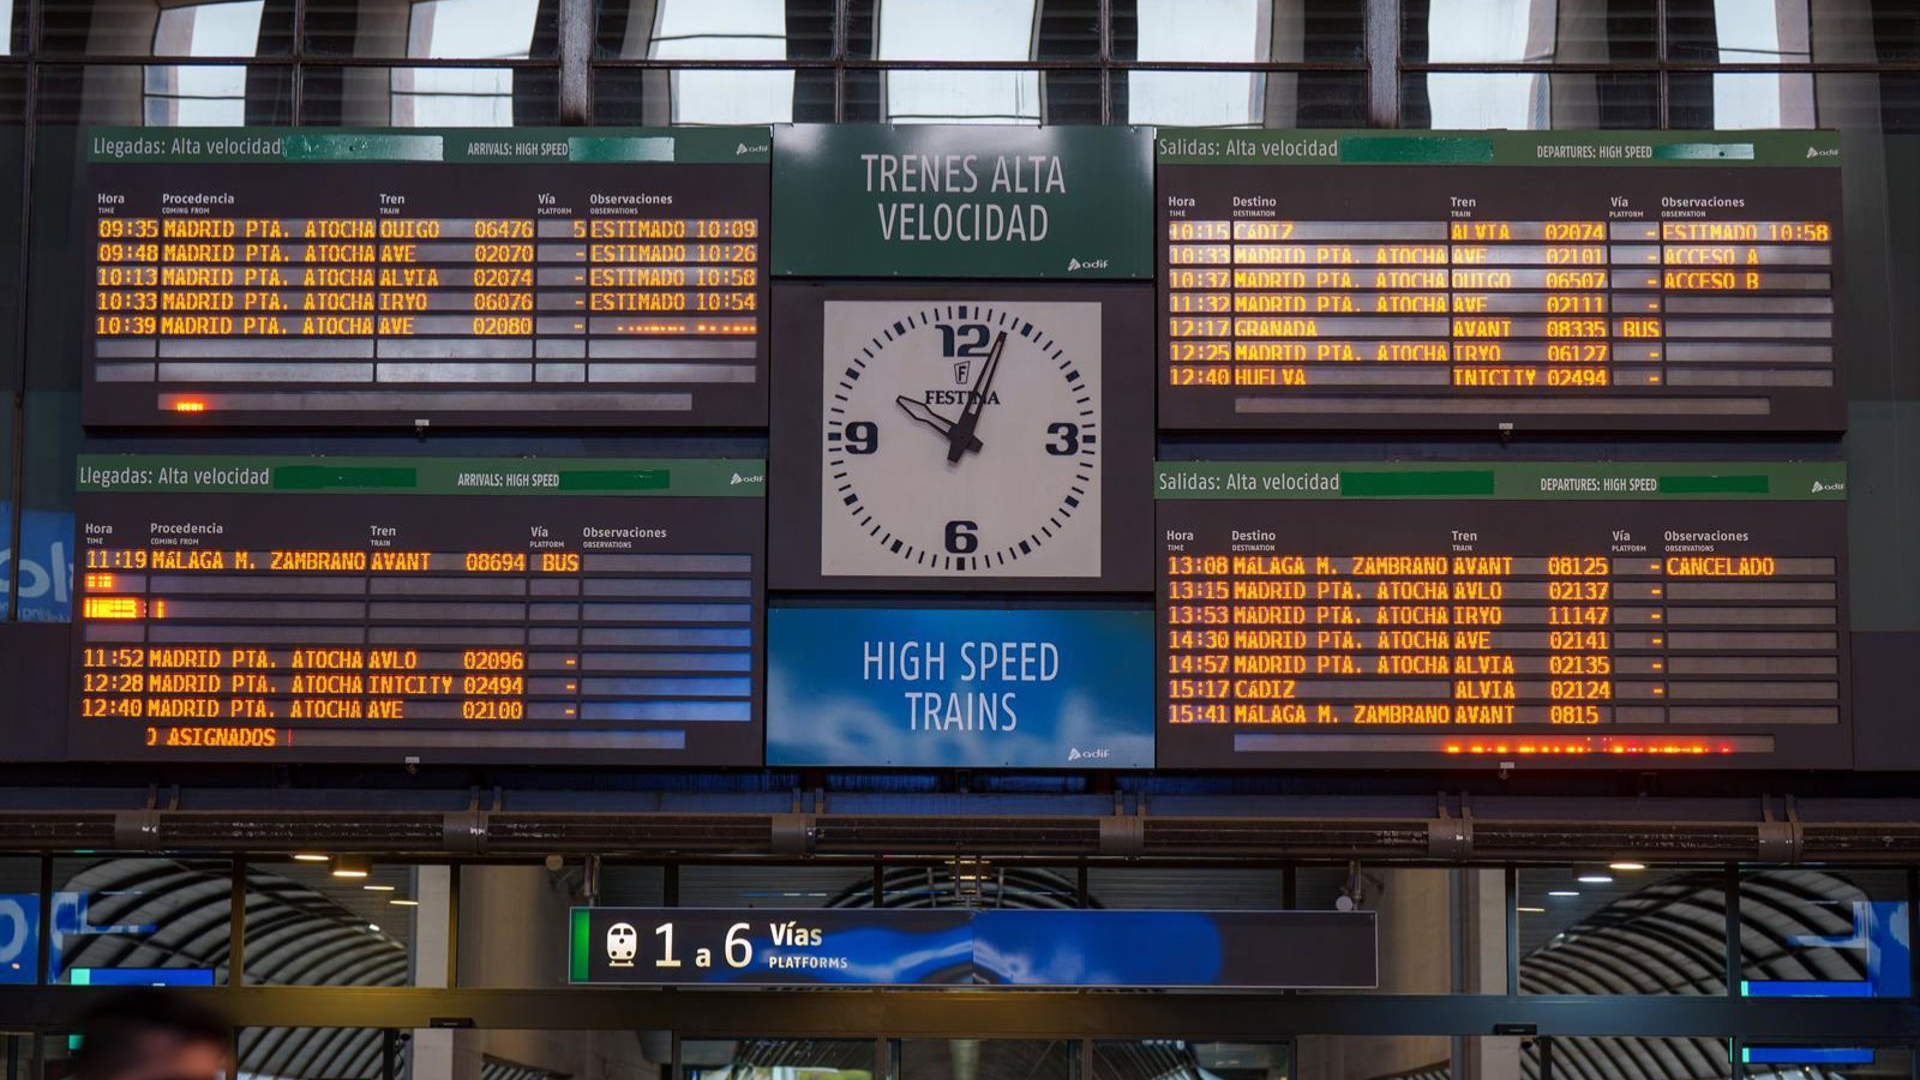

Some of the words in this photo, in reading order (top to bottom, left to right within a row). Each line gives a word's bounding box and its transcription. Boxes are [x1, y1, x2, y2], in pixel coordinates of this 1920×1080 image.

[94, 137, 166, 157] Llegadas:
[172, 138, 200, 155] Alta
[207, 137, 281, 155] velocidad
[468, 143, 512, 155] ARRIVALS:
[516, 143, 538, 156] HIGH
[541, 143, 568, 156] SPEED
[1160, 139, 1220, 155] Salidas:
[1227, 139, 1255, 156] Alta
[1262, 140, 1338, 156] velocidad
[1537, 146, 1596, 158] DEPARTURES:
[1599, 146, 1621, 158] HIGH
[1625, 146, 1652, 158] SPEED
[861, 154, 978, 193] TRENES
[991, 155, 1066, 193] ALTA
[98, 194, 124, 204] Hora
[162, 193, 234, 204] Procedencia
[380, 194, 405, 204] Tren
[538, 193, 555, 204] Vía
[590, 194, 672, 204] Observaciones
[1168, 197, 1195, 207] Hora
[1233, 196, 1276, 207] Destino
[1451, 197, 1476, 207] Tren
[1611, 196, 1628, 207] Vía
[1661, 197, 1744, 208] Observaciones
[100, 220, 158, 238] 09:35
[164, 220, 235, 238] MADRID
[246, 220, 289, 238] PTA.
[305, 220, 376, 238] ATOCHA
[381, 220, 439, 238] OUIGO
[474, 220, 534, 238] 06476
[574, 220, 586, 238] 5
[591, 220, 685, 238] ESTIMADO
[696, 220, 756, 238] 10:09
[879, 203, 1048, 241] VELOCIDAD
[99, 244, 158, 262] 09:48
[380, 244, 415, 262] AVE
[474, 244, 533, 262] 02070
[591, 244, 685, 262] ESTIMADO
[696, 244, 756, 262] 10:26
[98, 269, 157, 286] 10:13
[380, 269, 438, 286] ALVIA
[474, 269, 533, 286] 02074
[591, 269, 685, 286] ESTIMADO
[696, 269, 756, 286] 10:58
[98, 292, 157, 310] 10:33
[379, 292, 426, 310] IRYO
[473, 292, 533, 310] 06076
[591, 292, 685, 310] ESTIMADO
[696, 292, 756, 310] 10:54
[97, 317, 156, 334] 10:39
[161, 317, 232, 334] MADRID
[244, 317, 287, 334] PTA.
[303, 317, 374, 334] ATOCHA
[379, 317, 413, 334] AVE
[473, 317, 532, 334] 02080
[935, 324, 991, 357] 12
[845, 421, 878, 454] 9
[1046, 423, 1079, 456] 3
[80, 467, 152, 487] Llegadas:
[158, 468, 188, 484] Alta
[194, 468, 269, 485] velocidad
[458, 474, 503, 487] ARRIVALS:
[506, 474, 529, 487] HIGH
[532, 474, 560, 487] SPEED
[1160, 474, 1220, 490] Salidas:
[1226, 474, 1256, 490] Alta
[1263, 473, 1339, 490] velocidad
[1541, 478, 1600, 491] DEPARTURES:
[1604, 478, 1626, 491] HIGH
[1630, 478, 1657, 491] SPEED
[86, 523, 113, 534] Hora
[151, 523, 223, 534] Procedencia
[371, 526, 396, 536] Tren
[531, 526, 548, 538] Vía
[583, 527, 667, 538] Observaciones
[1167, 531, 1194, 541] Hora
[1232, 530, 1276, 541] Destino
[1452, 531, 1477, 541] Tren
[1612, 530, 1630, 542] Vía
[1664, 531, 1748, 542] Observaciones
[945, 521, 978, 554] 6
[87, 551, 147, 569] 11:19
[235, 552, 255, 570] M.
[271, 552, 366, 570] ZAMBRANO
[371, 552, 431, 570] AVANT
[466, 553, 526, 571] 08694
[542, 554, 579, 571] BUS
[1168, 557, 1228, 575] 13:08
[1317, 557, 1338, 575] M.
[1353, 557, 1448, 575] ZAMBRANO
[1453, 557, 1512, 575] AVANT
[1548, 558, 1608, 575] 08125
[1667, 558, 1775, 575] CANCELADO
[1169, 582, 1229, 599] 13:15
[1454, 582, 1502, 600] AVLO
[1550, 582, 1608, 600] 02137
[1169, 606, 1229, 624] 13:53
[1454, 607, 1502, 624] IRYO
[1549, 607, 1608, 624] 11147
[84, 649, 144, 667] 11:52
[150, 650, 221, 668] MADRID
[232, 650, 275, 668] PTA.
[292, 651, 363, 668] ATOCHA
[369, 651, 416, 669] AVLO
[464, 652, 523, 669] 02096
[863, 642, 945, 680] HIGH
[960, 642, 1058, 681] SPEED
[1169, 656, 1229, 673] 14:57
[1455, 656, 1514, 674] ALVIA
[1550, 656, 1610, 674] 02135
[83, 674, 144, 692] 12:28
[369, 676, 452, 694] INTCITY
[464, 676, 523, 694] 02494
[1169, 681, 1230, 698] 15:17
[1456, 681, 1514, 699] ALVIA
[1551, 681, 1610, 699] 02124
[83, 699, 142, 717] 12:40
[367, 701, 404, 718] AVE
[463, 701, 522, 719] 02100
[905, 692, 1016, 731] TRAINS
[1169, 705, 1226, 723] 15:41
[1354, 705, 1449, 723] ZAMBRANO
[1455, 706, 1514, 723] AVANT
[1551, 706, 1598, 724] 0815
[167, 728, 276, 746] ASIGNADOS
[770, 921, 822, 946] Vías
[655, 923, 681, 967] 1
[695, 947, 711, 968] a
[725, 923, 753, 968] 6
[769, 957, 848, 969] PLATFORMS
